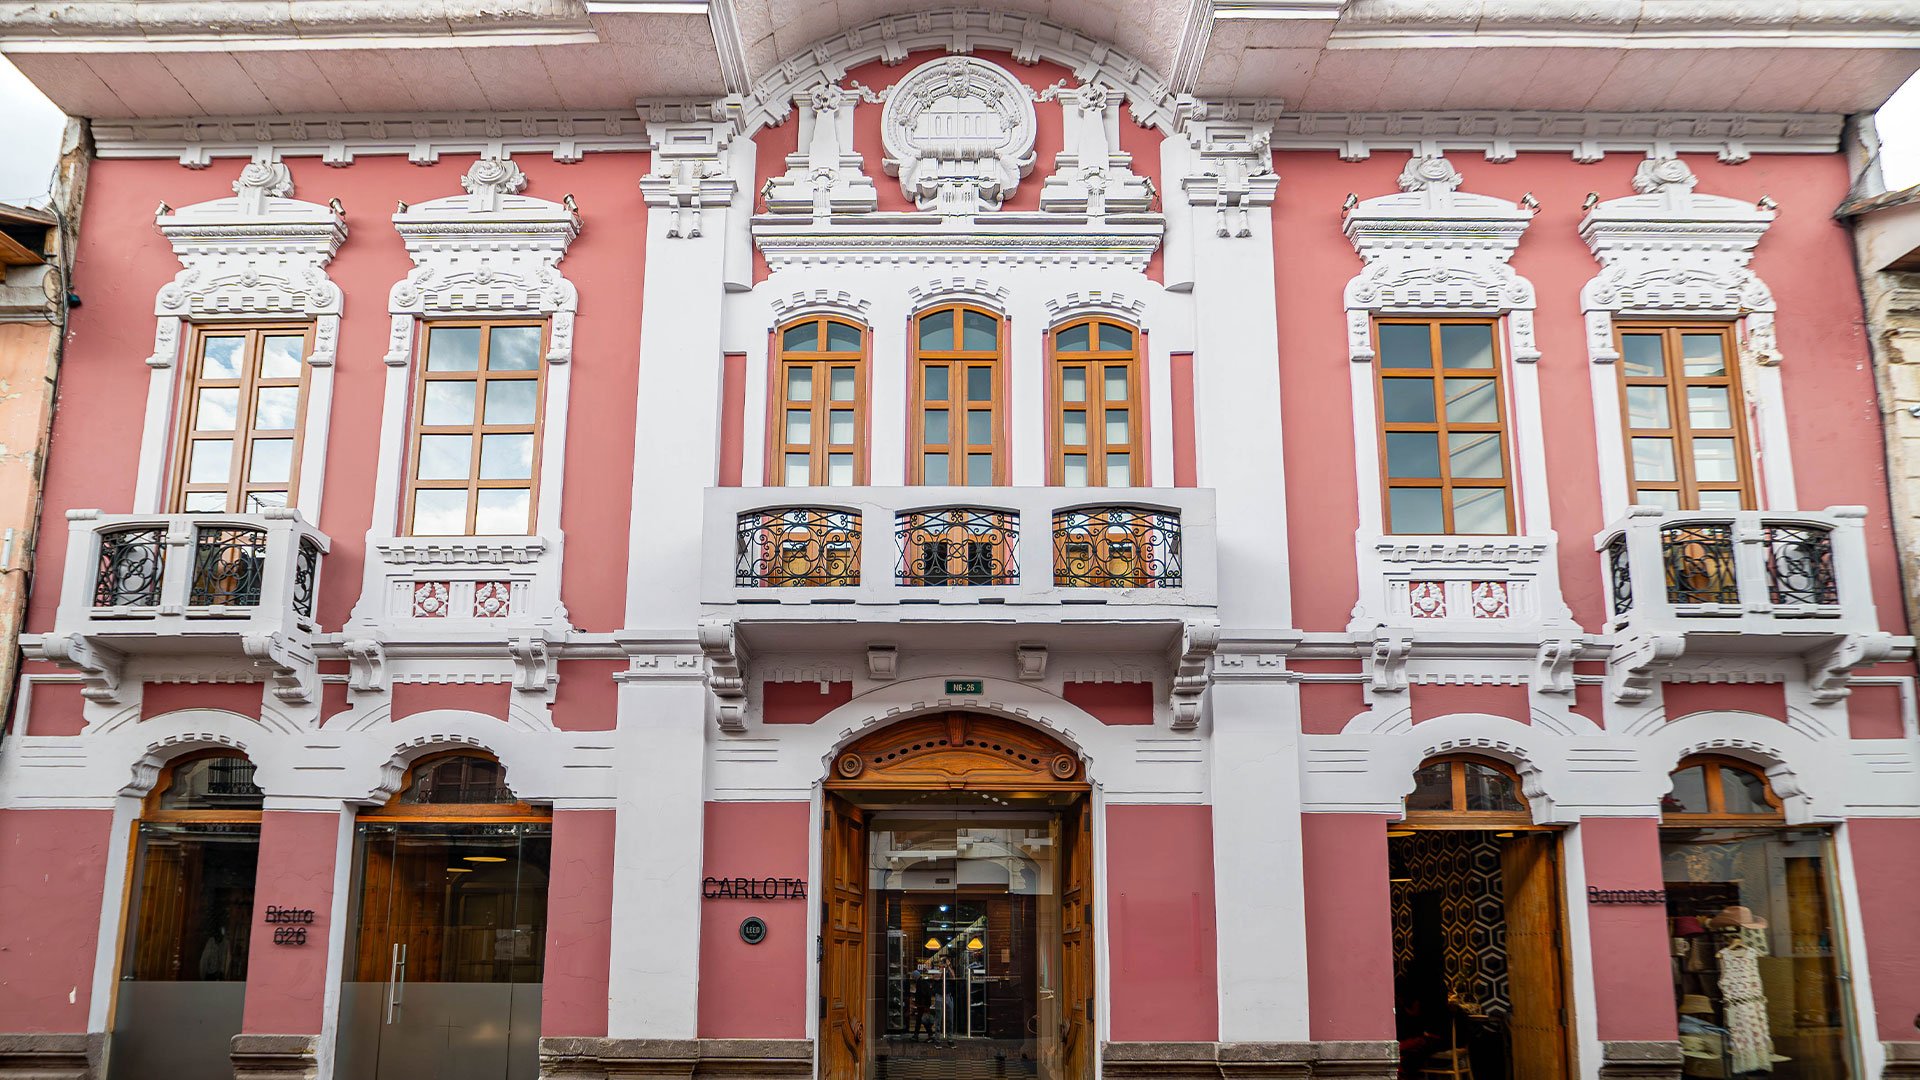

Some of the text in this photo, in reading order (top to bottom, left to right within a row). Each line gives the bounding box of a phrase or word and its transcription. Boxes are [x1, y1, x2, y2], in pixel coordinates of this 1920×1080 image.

[953, 683, 975, 692] N6-26
[702, 877, 806, 899] CARLOTA
[265, 905, 315, 923] Bistro
[273, 927, 307, 945] 626
